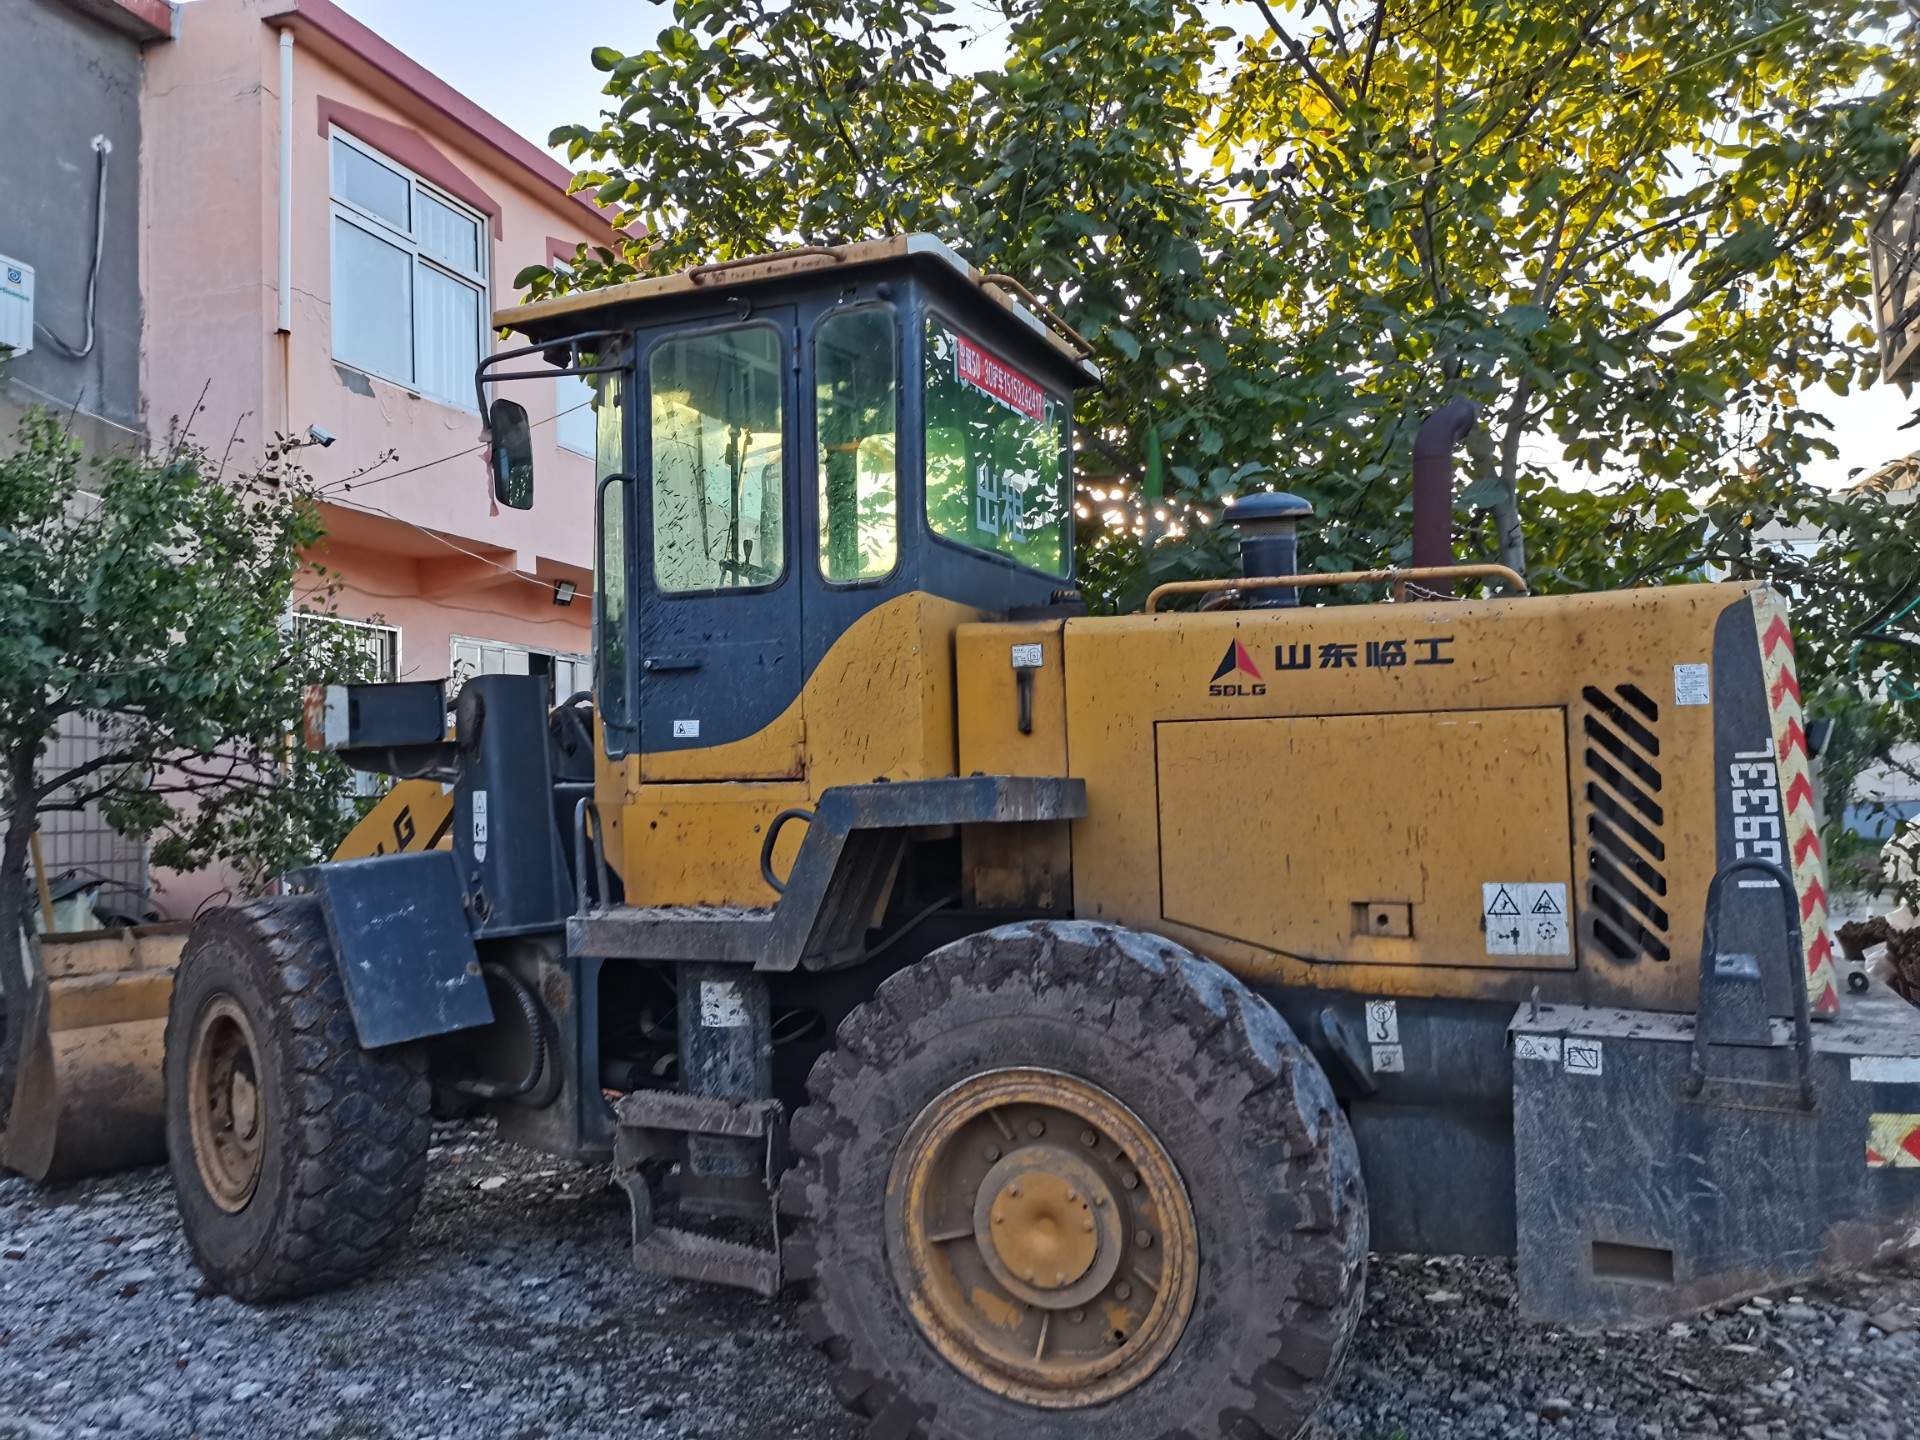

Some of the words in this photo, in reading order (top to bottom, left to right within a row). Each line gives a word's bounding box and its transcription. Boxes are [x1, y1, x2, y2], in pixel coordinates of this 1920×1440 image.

[1275, 635, 1455, 671] 山东临工
[1208, 683, 1267, 697] SDLG
